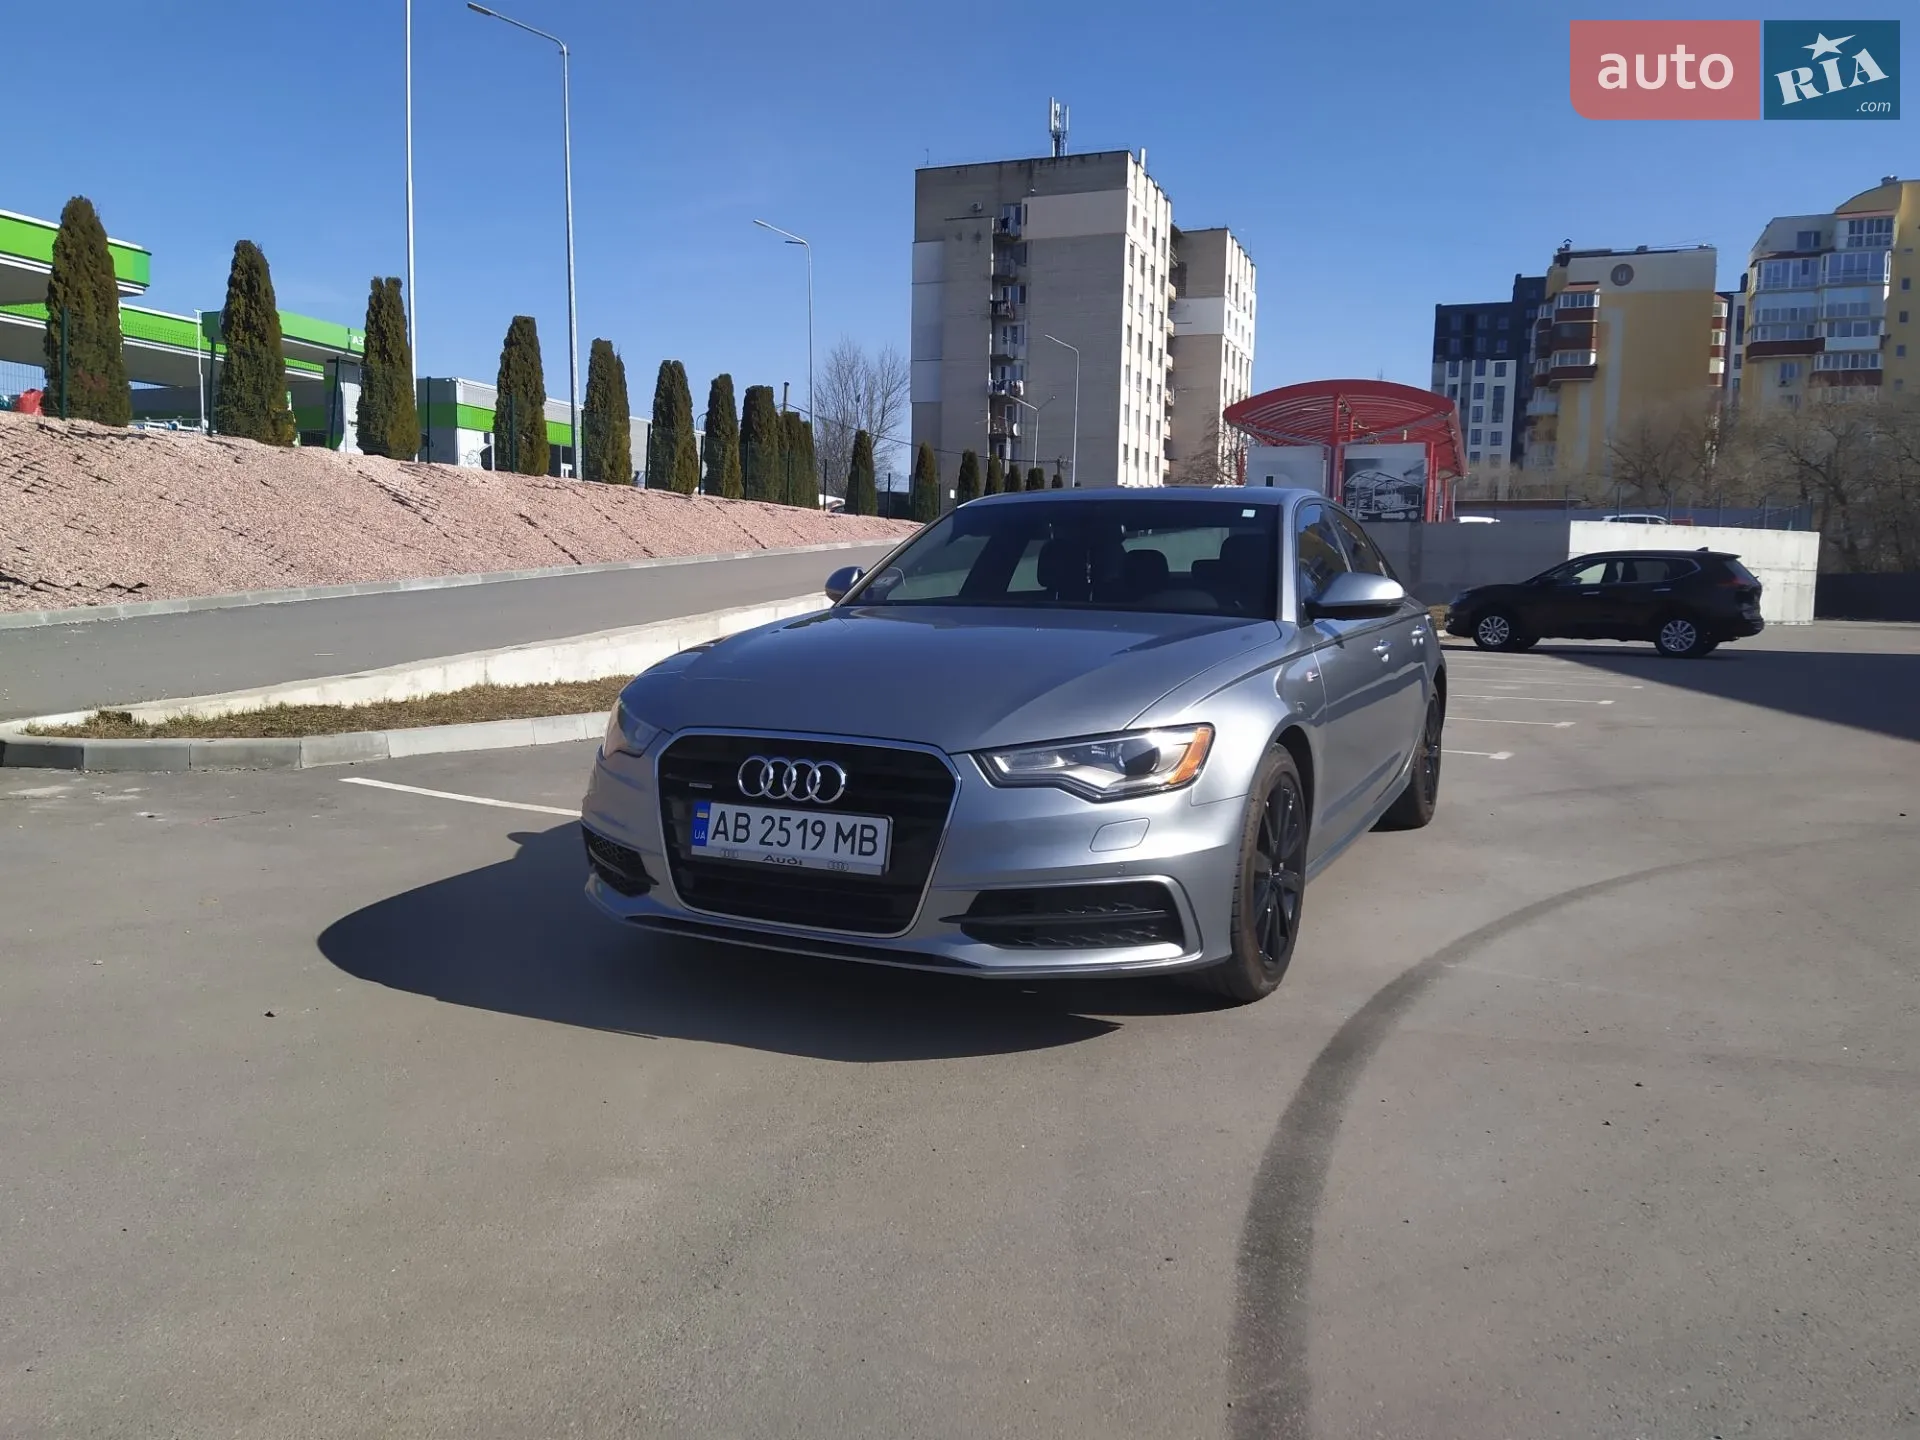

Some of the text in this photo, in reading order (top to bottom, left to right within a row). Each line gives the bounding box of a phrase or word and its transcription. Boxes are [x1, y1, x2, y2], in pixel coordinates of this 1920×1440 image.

[694, 829, 706, 840] UA
[711, 811, 878, 857] AB 2519 MB
[763, 854, 803, 866] Audi
